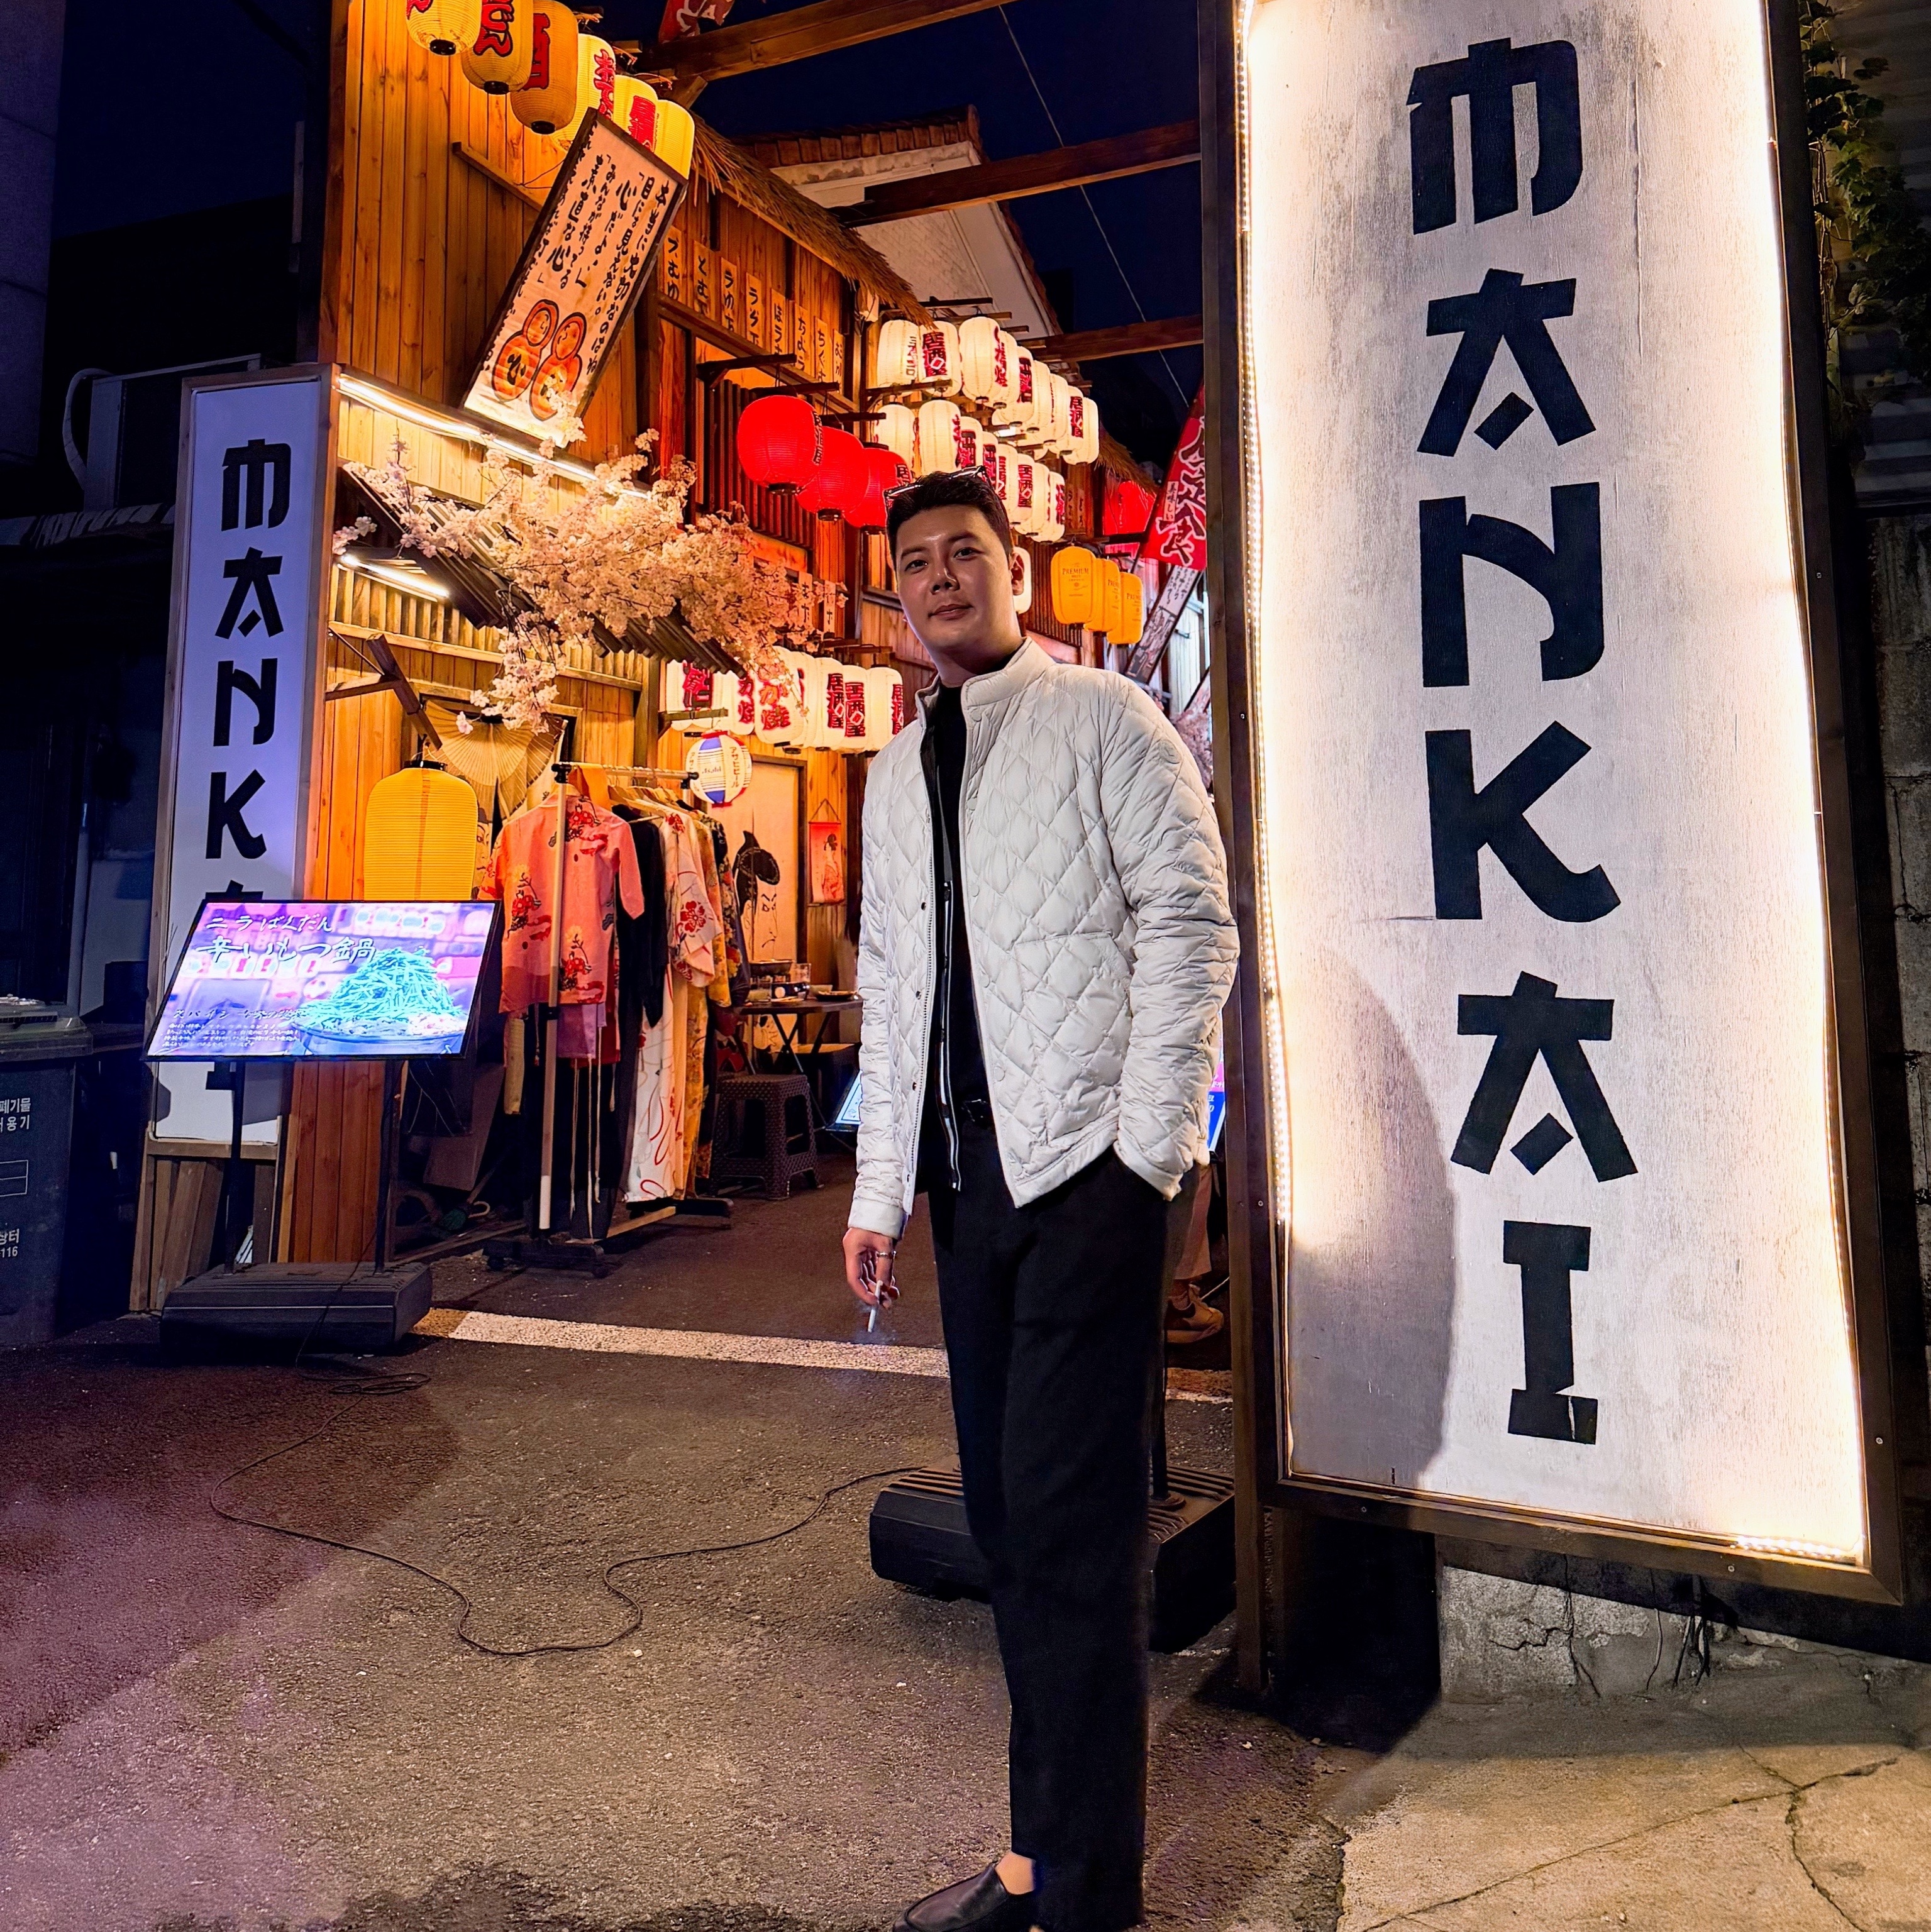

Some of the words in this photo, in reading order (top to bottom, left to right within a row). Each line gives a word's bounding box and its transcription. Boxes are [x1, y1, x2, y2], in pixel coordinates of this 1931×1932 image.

[205, 438, 292, 901] MANK
[844, 682, 866, 737] 居酒屋
[1406, 37, 1638, 1445] MANKAI
